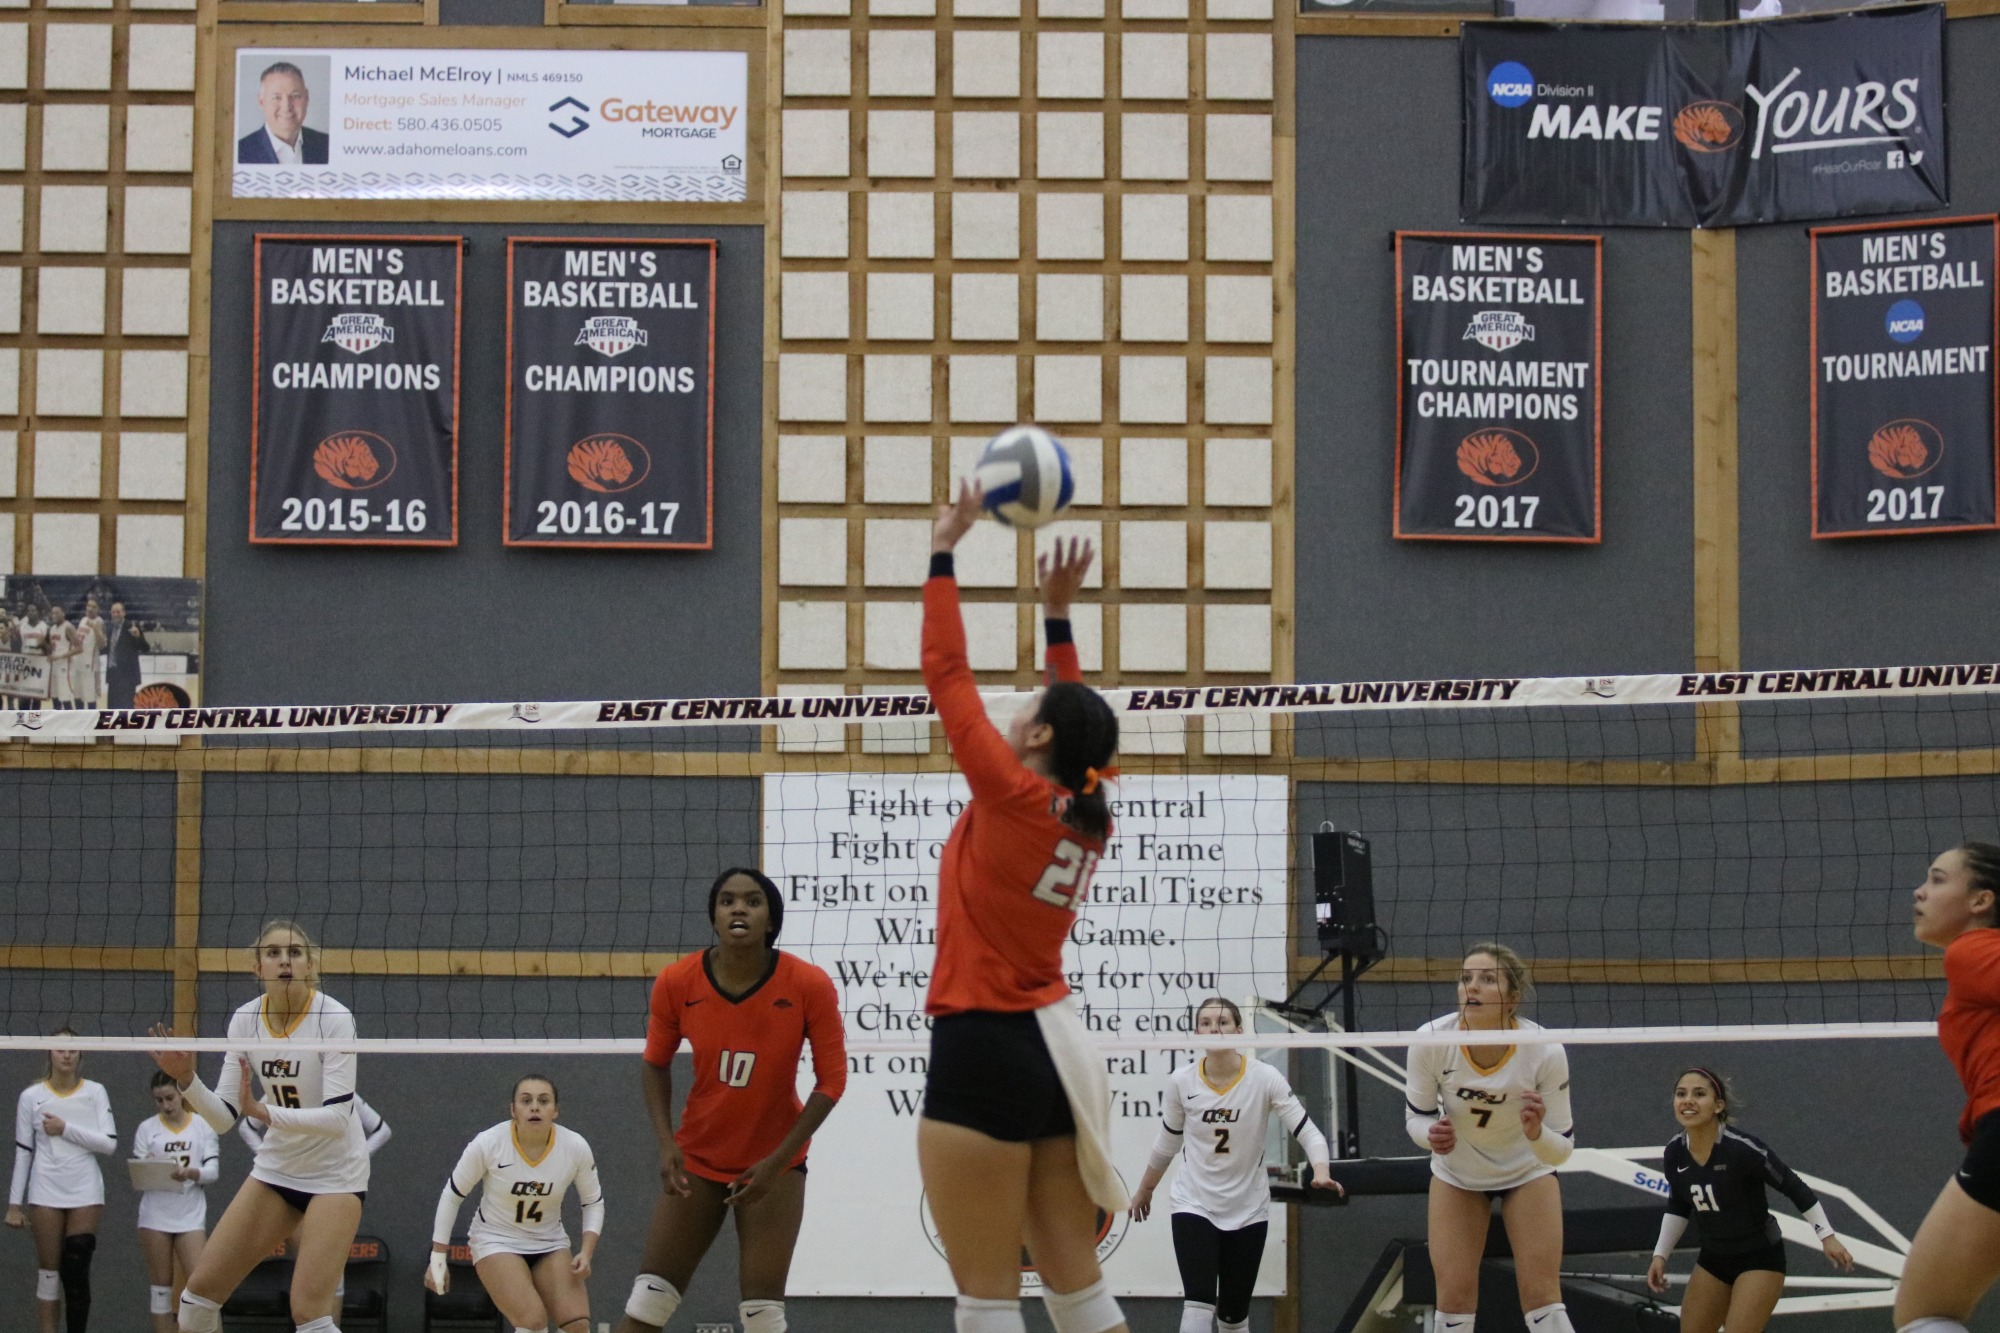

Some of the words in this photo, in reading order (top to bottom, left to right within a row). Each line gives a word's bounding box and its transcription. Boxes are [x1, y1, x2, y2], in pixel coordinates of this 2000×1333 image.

[345, 66, 413, 82] Michael
[420, 66, 492, 85] McElroy
[507, 73, 538, 82] NMLS
[542, 73, 583, 83] 469150
[344, 93, 415, 109] Mortgage
[420, 93, 457, 106] Sales
[462, 94, 526, 109] Manager
[1492, 83, 1533, 97] NCAA
[1537, 84, 1584, 97] Division
[343, 117, 392, 131] Direct:
[397, 118, 502, 131] 580.436.0505
[600, 97, 738, 130] Gateway
[1527, 104, 1662, 141] MAKE
[1745, 67, 1919, 160] YOURS
[642, 127, 717, 139] MORTGAGE
[342, 143, 528, 156] www.adahomeloans.com
[312, 247, 404, 275] MEN'S
[1451, 245, 1544, 273] MEN'S
[1861, 232, 1946, 264] MEN'S
[565, 250, 657, 277] MEN'S
[271, 278, 445, 306] BASKETBALL
[1412, 275, 1584, 305] BASKETBALL
[1825, 261, 1984, 298] BASKETBALL
[523, 280, 698, 309] BASKETBALL
[340, 316, 377, 325] GREAT
[593, 318, 630, 328] GREAT
[1465, 323, 1534, 339] AMERICAN
[1481, 313, 1517, 323] GREAT
[1889, 319, 1924, 333] NCAA
[324, 325, 393, 341] AMERICAN
[577, 327, 646, 344] AMERICAN
[272, 362, 441, 390] CHAMPIONS
[1407, 358, 1589, 389] TOURNAMENT
[1822, 345, 1990, 383] TOURNAMENT
[525, 365, 695, 393] CHAMPIONS
[1417, 391, 1579, 420] CHAMPIONS
[281, 498, 427, 532] 2015-16
[537, 500, 680, 535] 2016-17
[1454, 494, 1540, 529] 2017
[1866, 485, 1945, 523] 2017
[1676, 673, 1754, 696] EAST
[1757, 668, 1893, 694] CENTRAL
[1898, 663, 2000, 688] UNIVE
[596, 701, 667, 723] EAST
[671, 697, 796, 721] CENTRAL
[801, 694, 936, 719] UNIVERSI
[1126, 688, 1200, 711] EAST
[1204, 684, 1336, 709] CENTRAL
[1340, 679, 1521, 705] UNIVERSITY
[94, 708, 162, 731] EAST
[164, 707, 284, 730] CENTRAL
[289, 703, 453, 729] UNIVERSITY
[847, 788, 933, 823] Fight
[1109, 790, 1207, 818] entral
[830, 831, 916, 865] Fight
[1137, 833, 1224, 861] Fame
[789, 874, 875, 909] Fight
[888, 883, 929, 903] on
[1084, 875, 1149, 904] tral
[1160, 876, 1264, 910] Tigers
[1070, 918, 1176, 946] Game.
[835, 960, 929, 989] We're
[1097, 961, 1145, 989] for
[1158, 970, 1217, 995] you
[856, 1003, 934, 1031] Chee
[1085, 1003, 1122, 1032] he
[1135, 1004, 1196, 1032] end
[719, 1049, 756, 1088] 10
[888, 1055, 928, 1074] on
[272, 1084, 301, 1109] 16
[1110, 1089, 1164, 1118] in!
[1470, 1107, 1493, 1128] 7
[1214, 1128, 1230, 1153] 2
[1634, 1171, 1672, 1194] Sch
[515, 1200, 543, 1223] 14
[1690, 1184, 1720, 1212] 21
[351, 1243, 378, 1258] ERS
